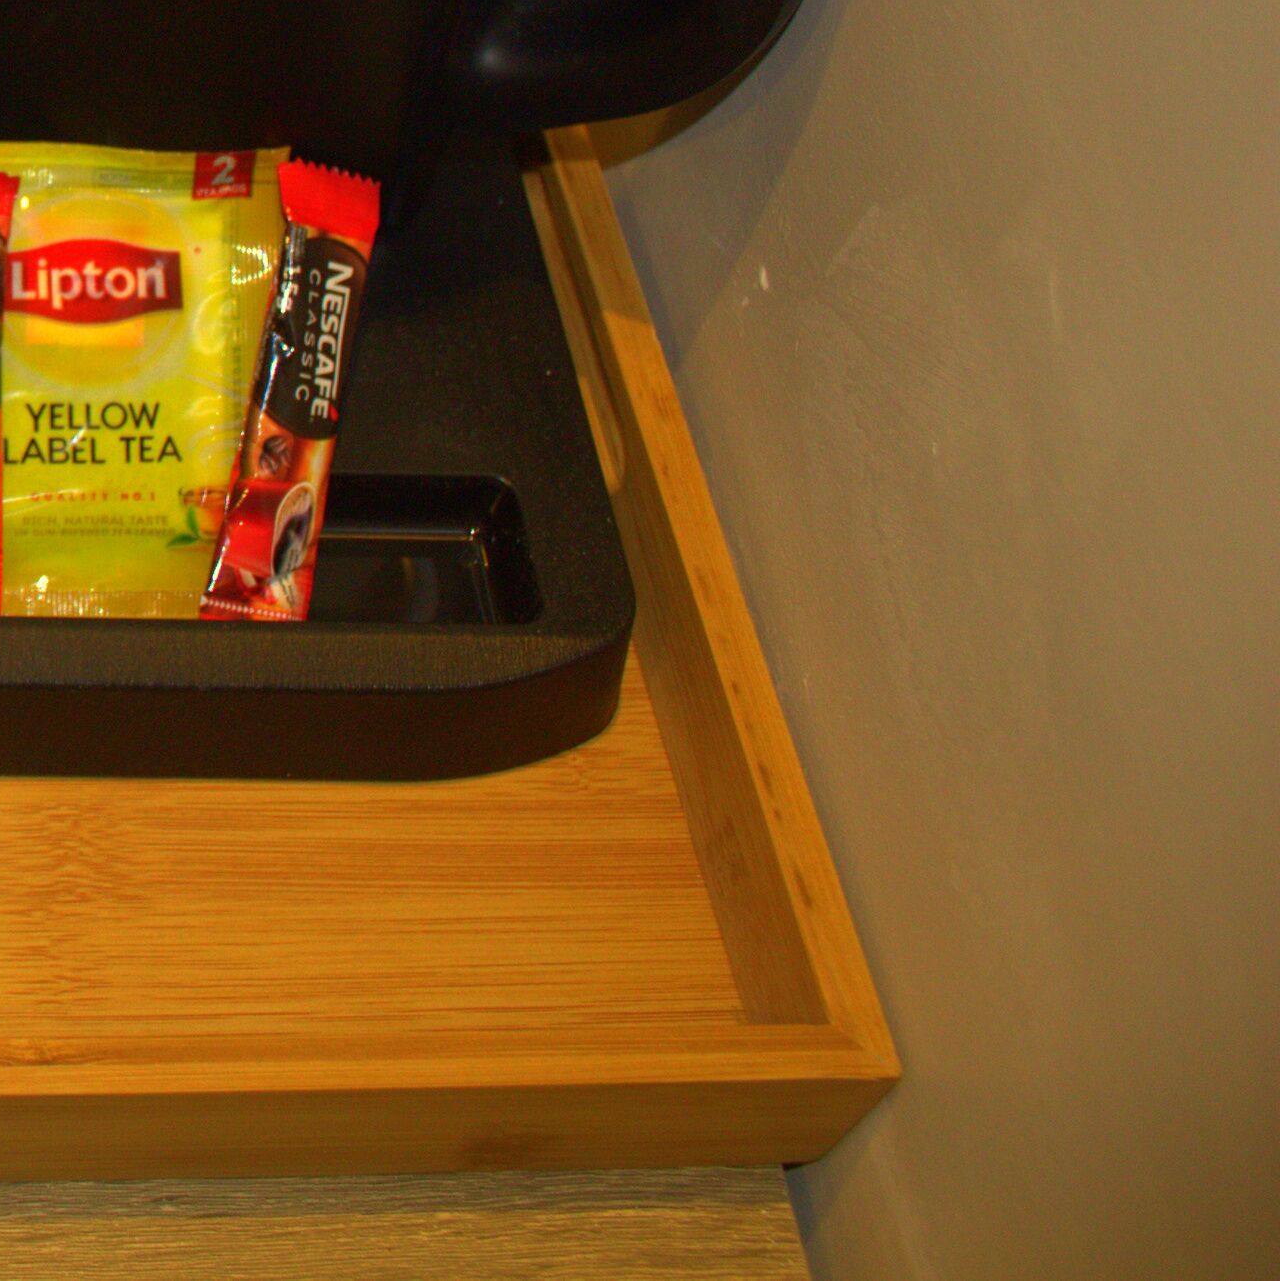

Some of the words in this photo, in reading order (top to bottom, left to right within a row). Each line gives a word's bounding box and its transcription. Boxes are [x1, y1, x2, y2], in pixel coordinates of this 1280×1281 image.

[211, 155, 236, 186] 2
[10, 258, 168, 310] Lipton
[294, 268, 322, 402] CLASSIC
[25, 402, 160, 432] YELLOW
[3, 437, 106, 465] LABEL
[119, 435, 183, 464] TEA
